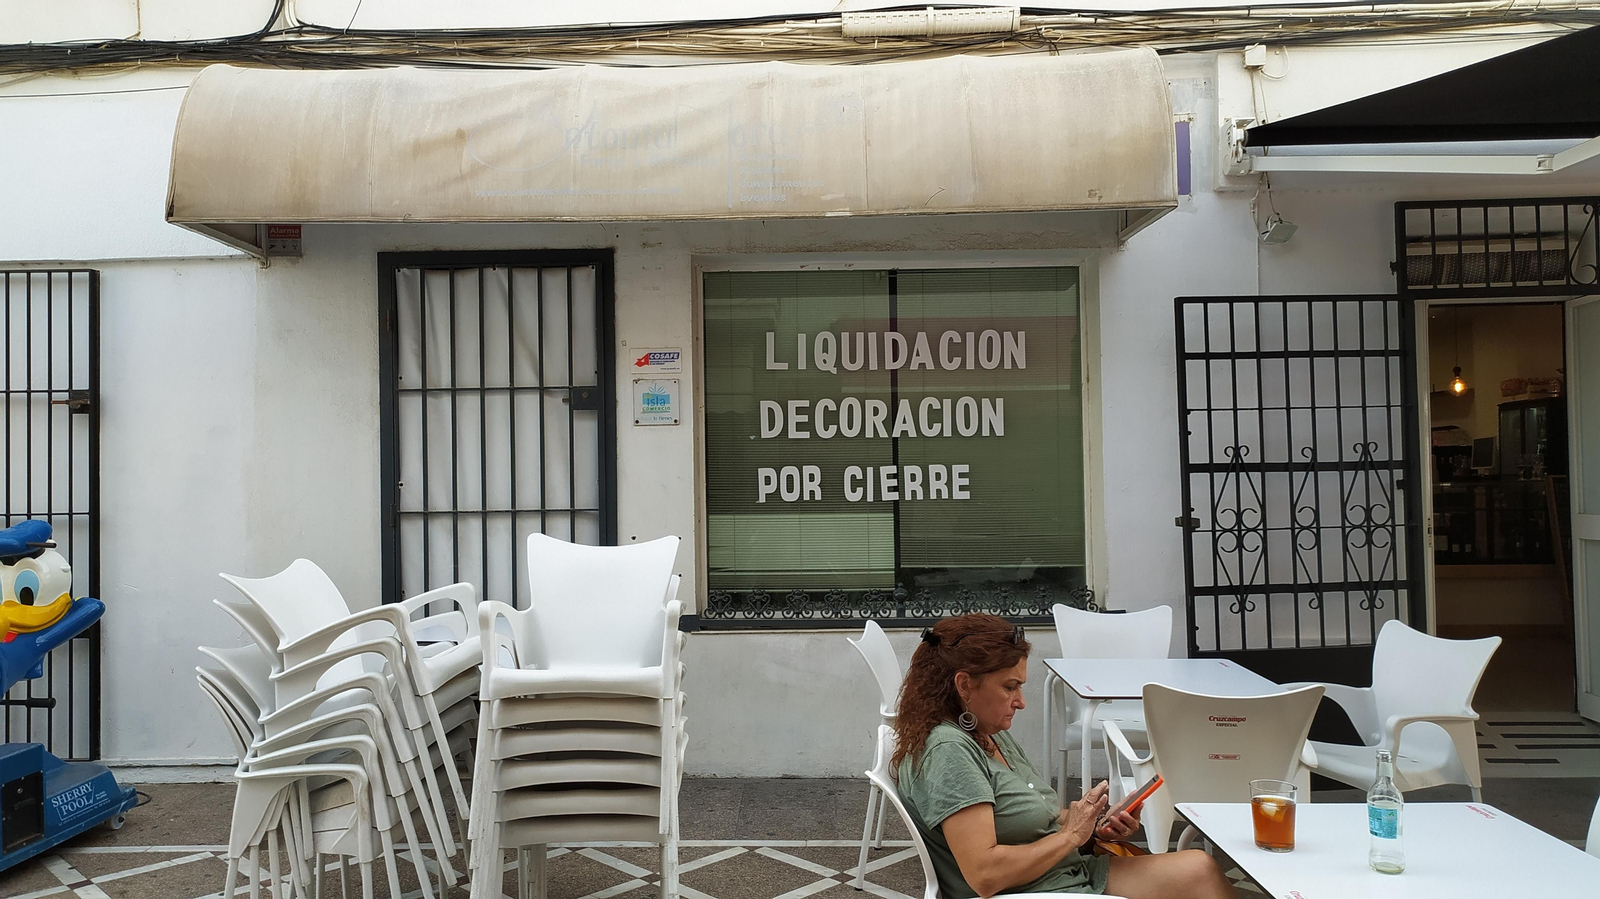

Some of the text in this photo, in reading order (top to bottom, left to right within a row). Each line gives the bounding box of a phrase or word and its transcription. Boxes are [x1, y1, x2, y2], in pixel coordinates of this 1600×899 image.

[740, 192, 787, 202] Eventos
[765, 329, 1026, 374] LIQUIDACION
[646, 396, 666, 407] isla
[759, 396, 1005, 439] DECORACION
[757, 464, 971, 503] POR CIERRE
[52, 782, 92, 808] SHERRY
[60, 795, 92, 816] POOL
